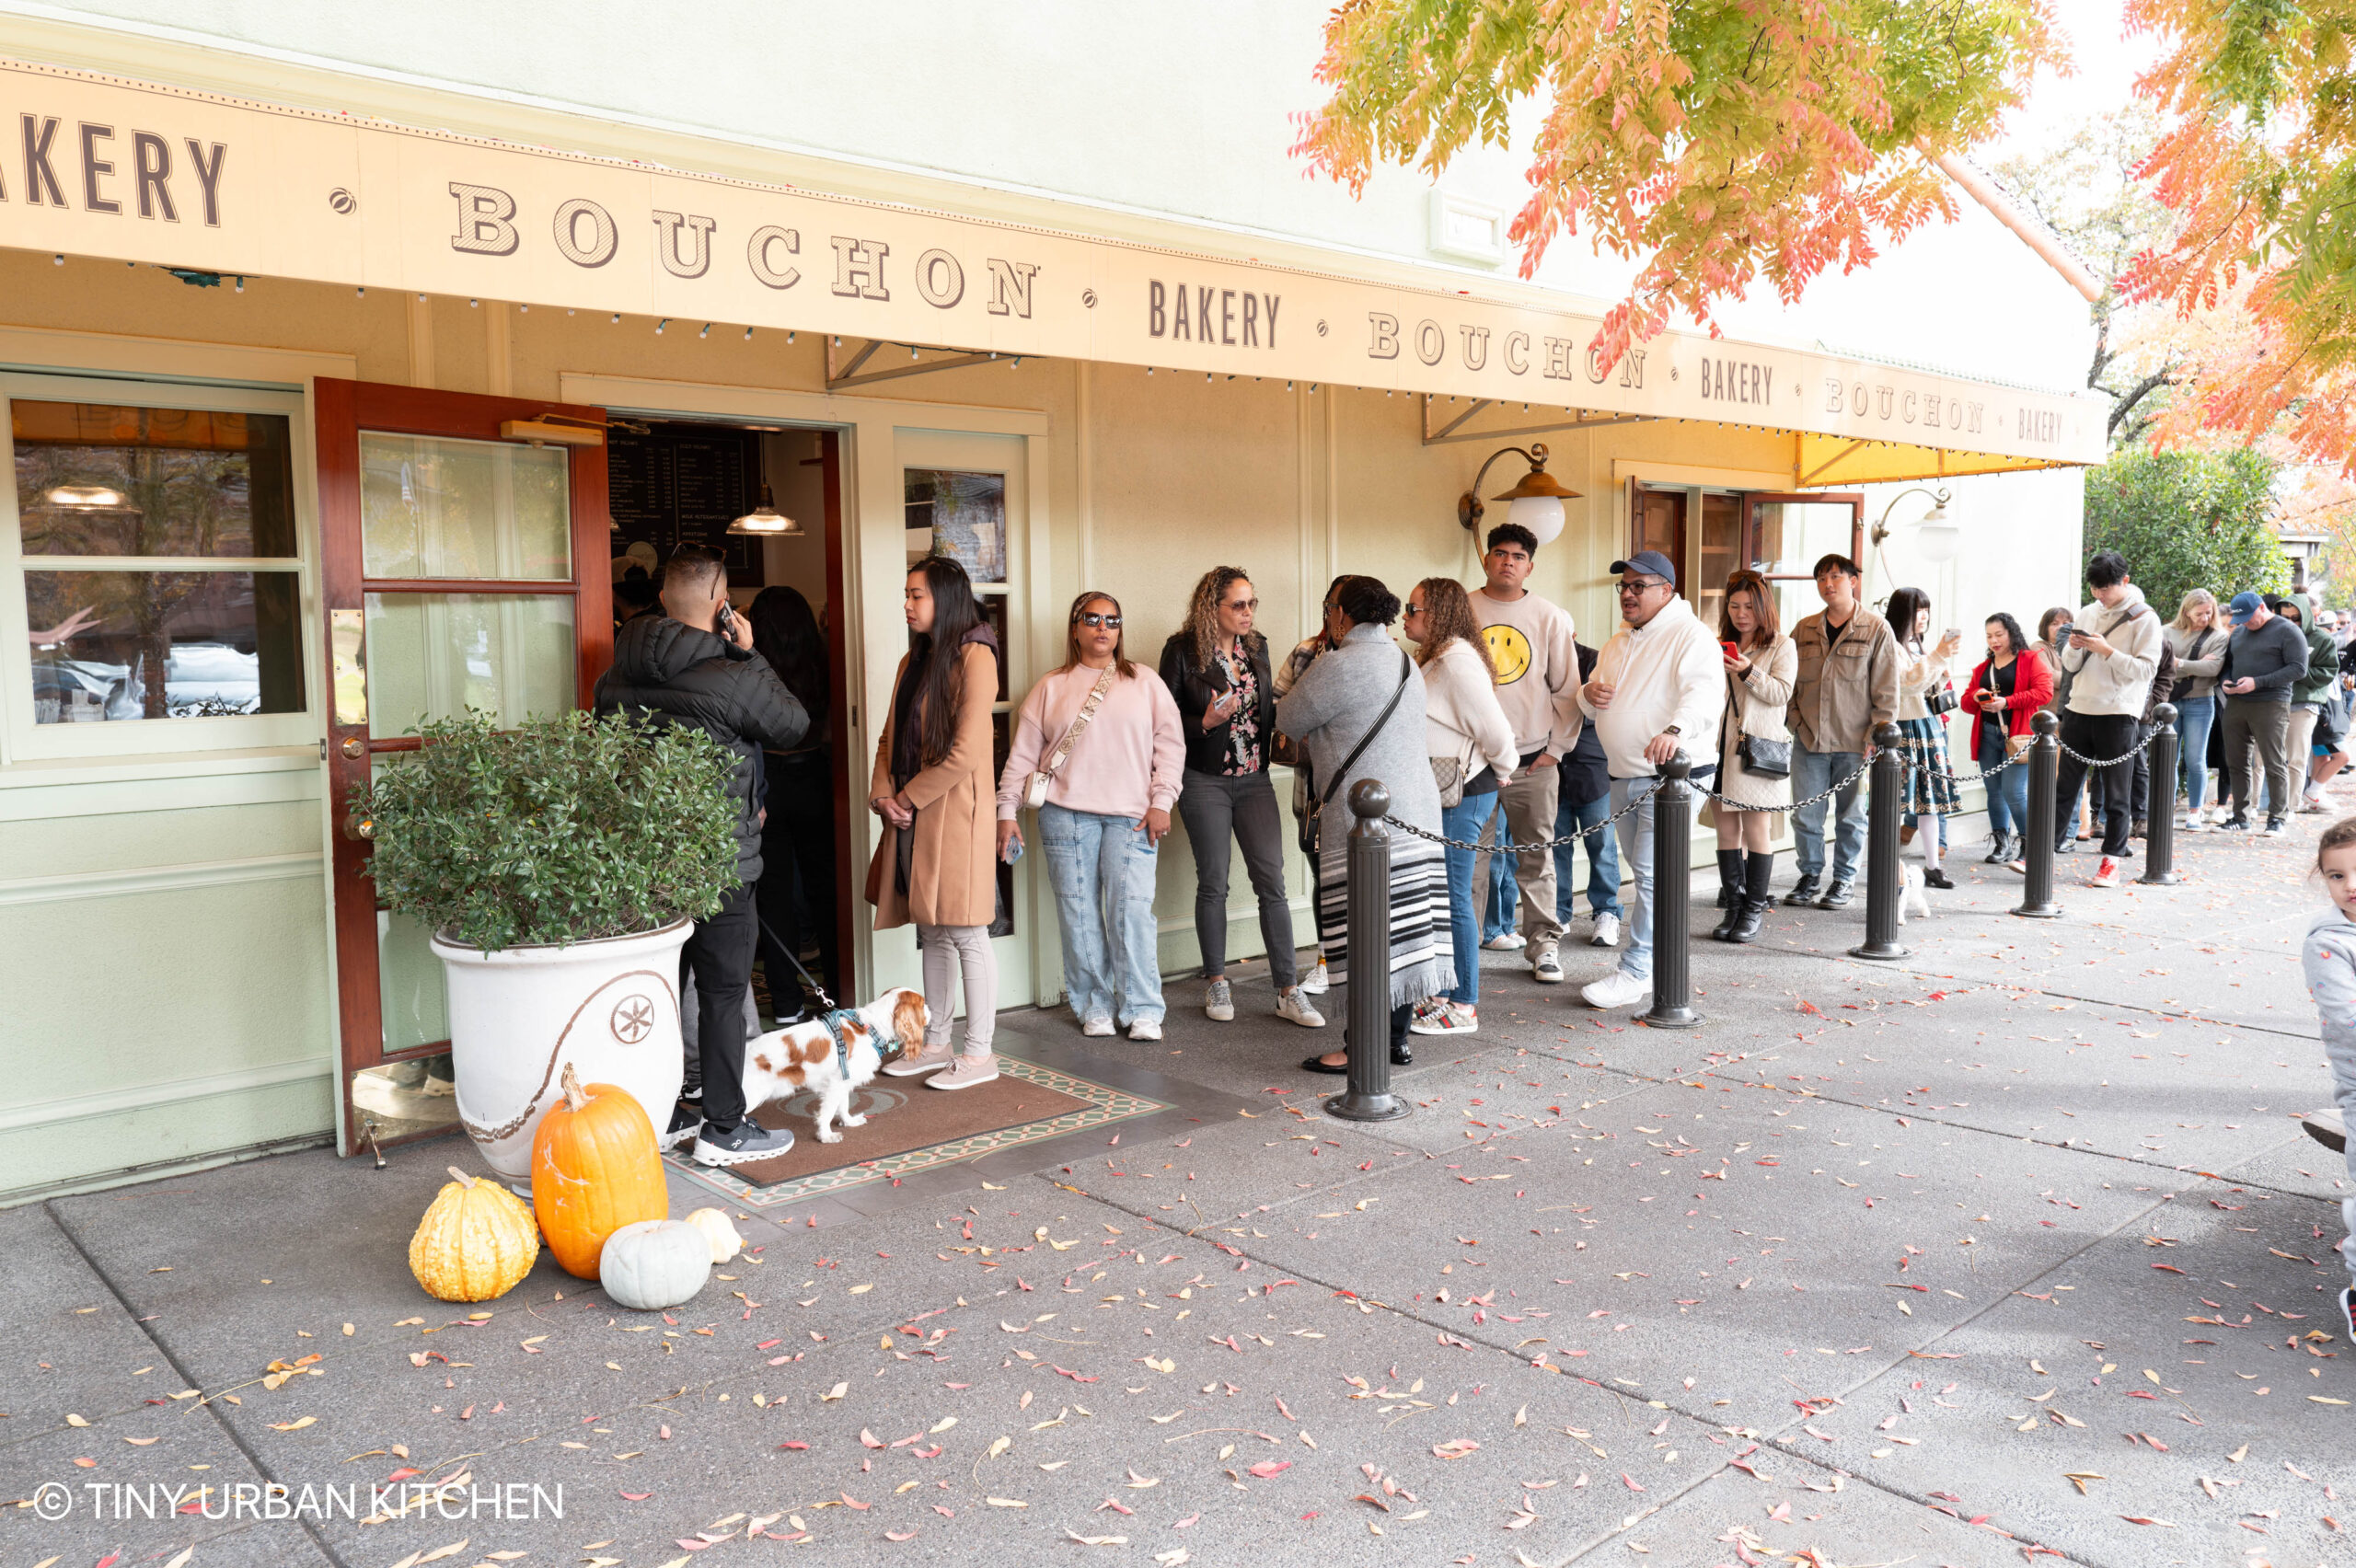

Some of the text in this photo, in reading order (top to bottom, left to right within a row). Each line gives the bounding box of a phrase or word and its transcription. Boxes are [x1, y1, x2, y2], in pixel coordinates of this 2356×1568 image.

[0, 112, 227, 228] KERY
[448, 181, 1036, 319] BOUCHON
[1149, 278, 1281, 350] BAKERY
[1369, 312, 1646, 389] BOUCHON
[1702, 357, 1773, 406] BAKERY
[1826, 378, 1983, 433] BOUCHON
[2019, 408, 2062, 444] BAKERY
